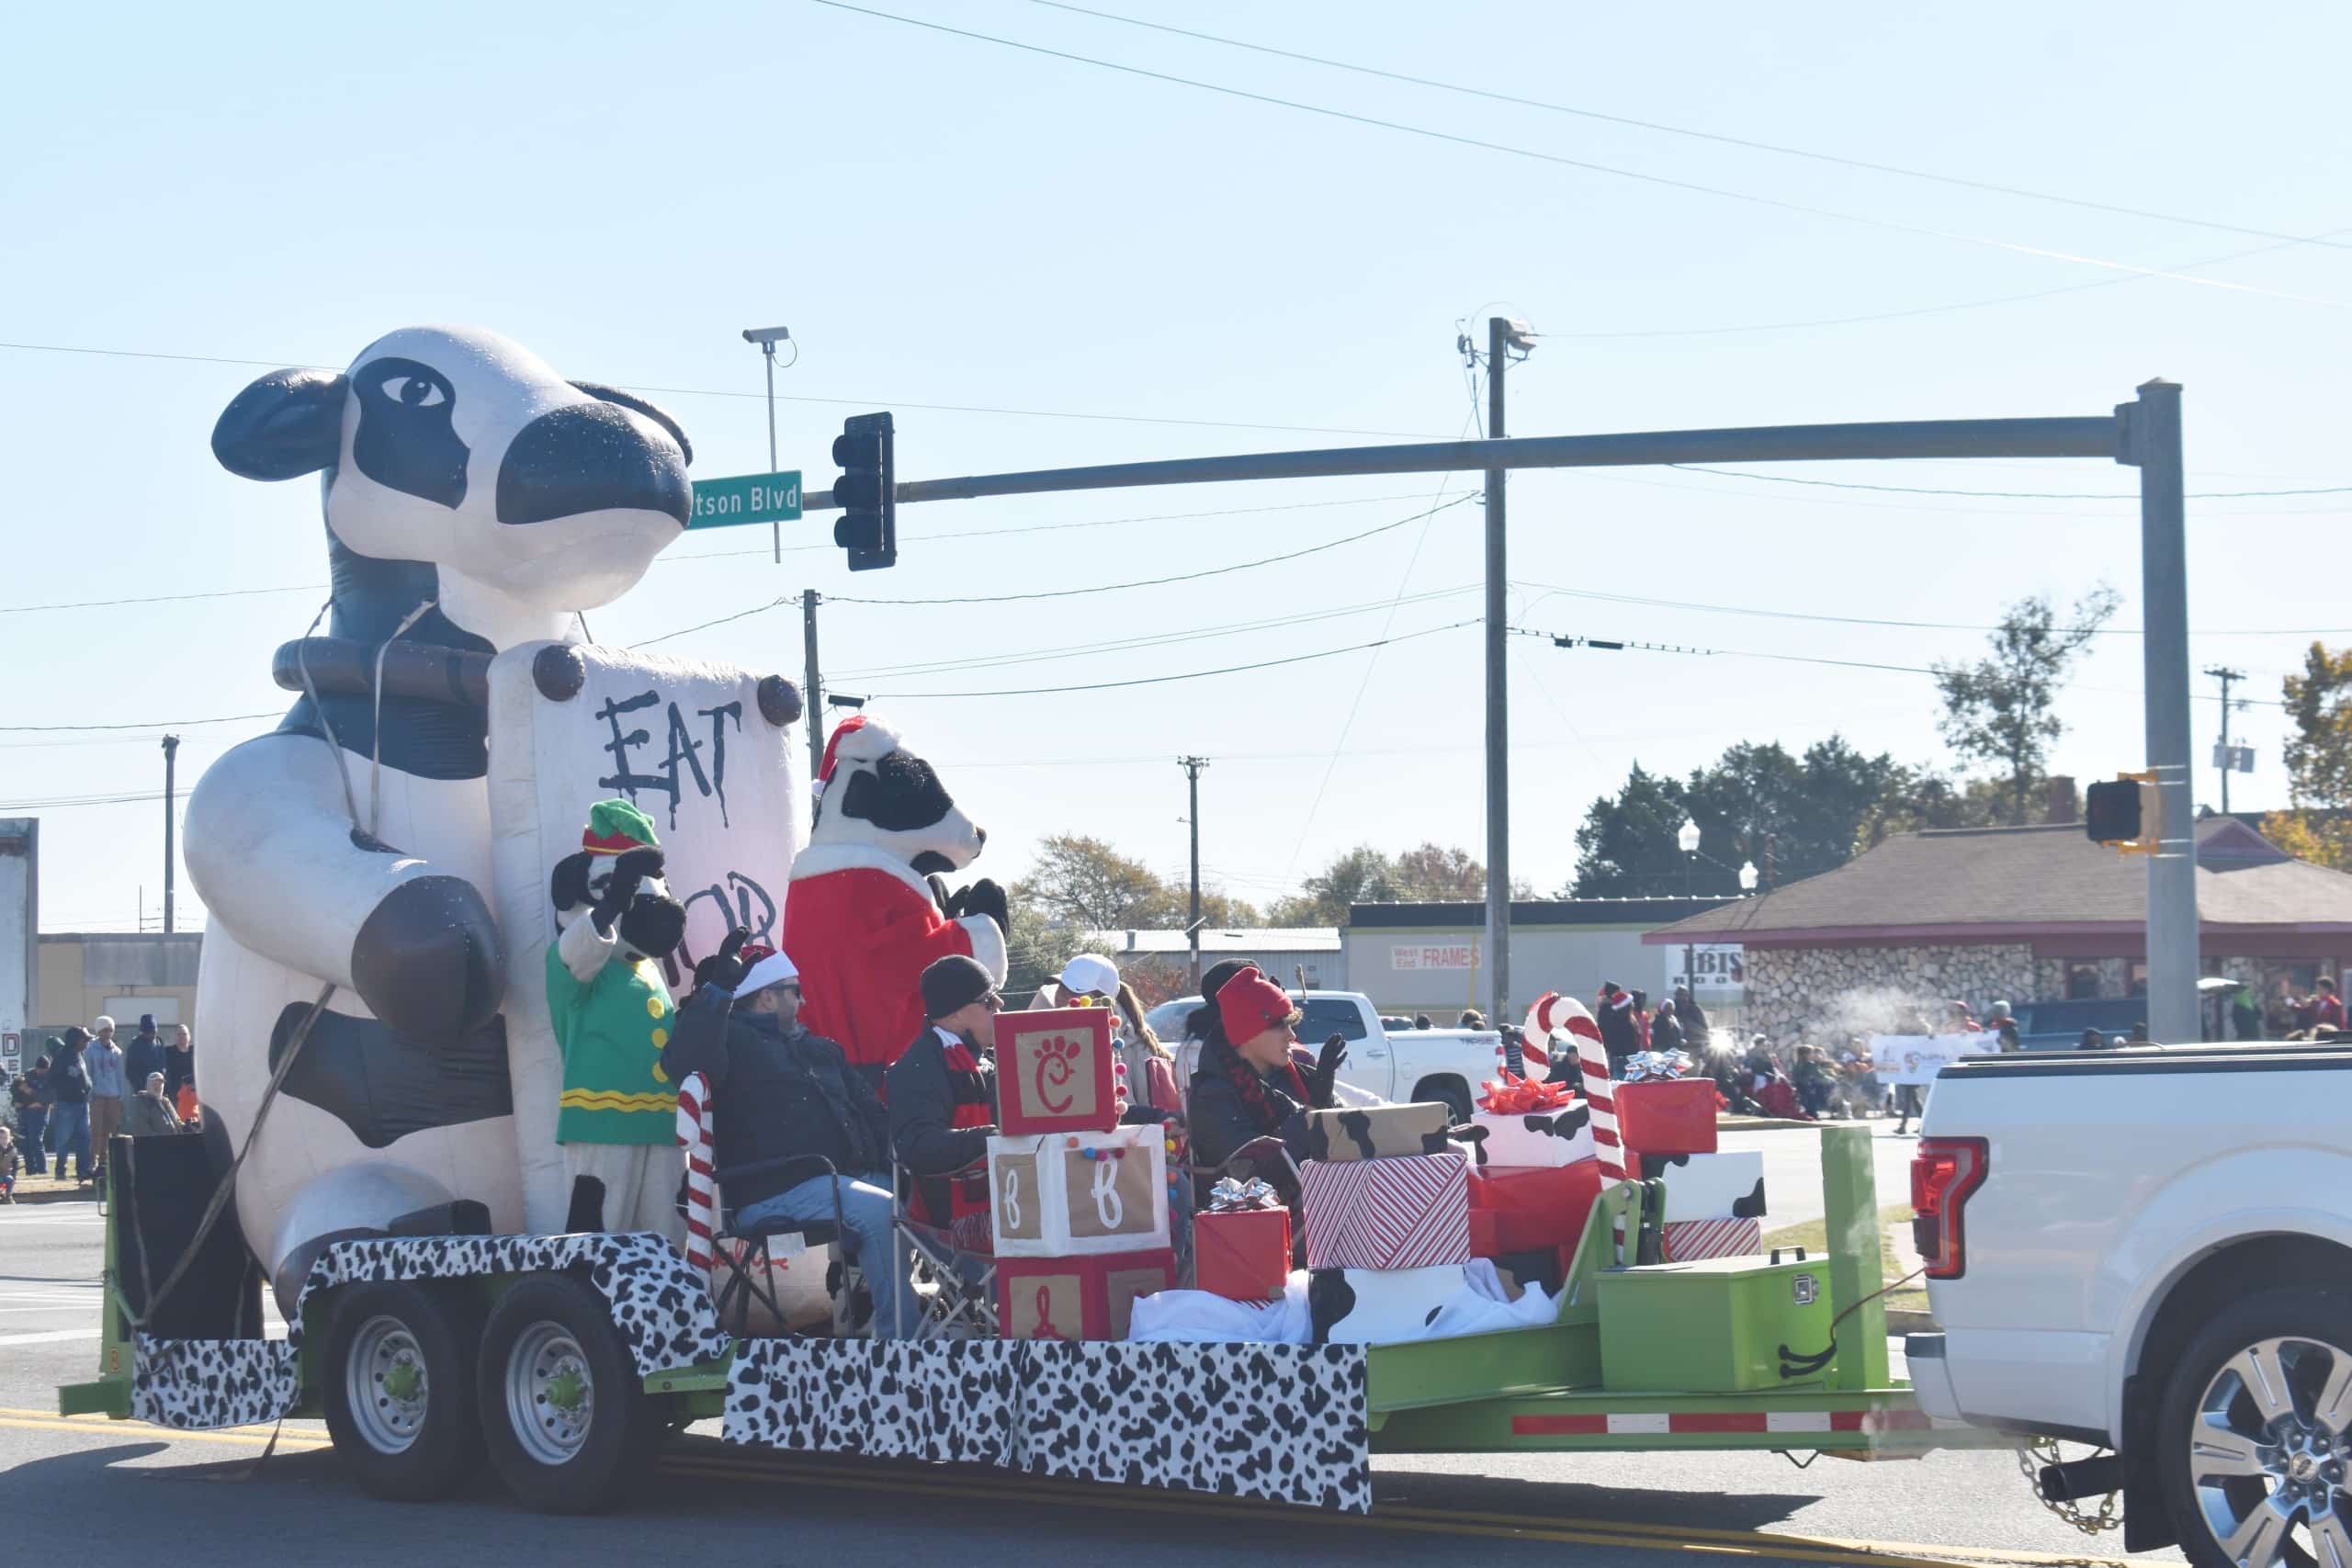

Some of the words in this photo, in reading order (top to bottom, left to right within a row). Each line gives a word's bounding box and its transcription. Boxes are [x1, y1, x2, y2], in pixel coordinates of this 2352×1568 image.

[691, 490, 741, 516] tson
[751, 484, 797, 512] Blvd
[594, 689, 742, 829] EAT
[1394, 947, 1419, 957] West
[1423, 947, 1479, 967] FRAMES
[1396, 958, 1416, 968] End
[1673, 976, 1728, 985] ROO
